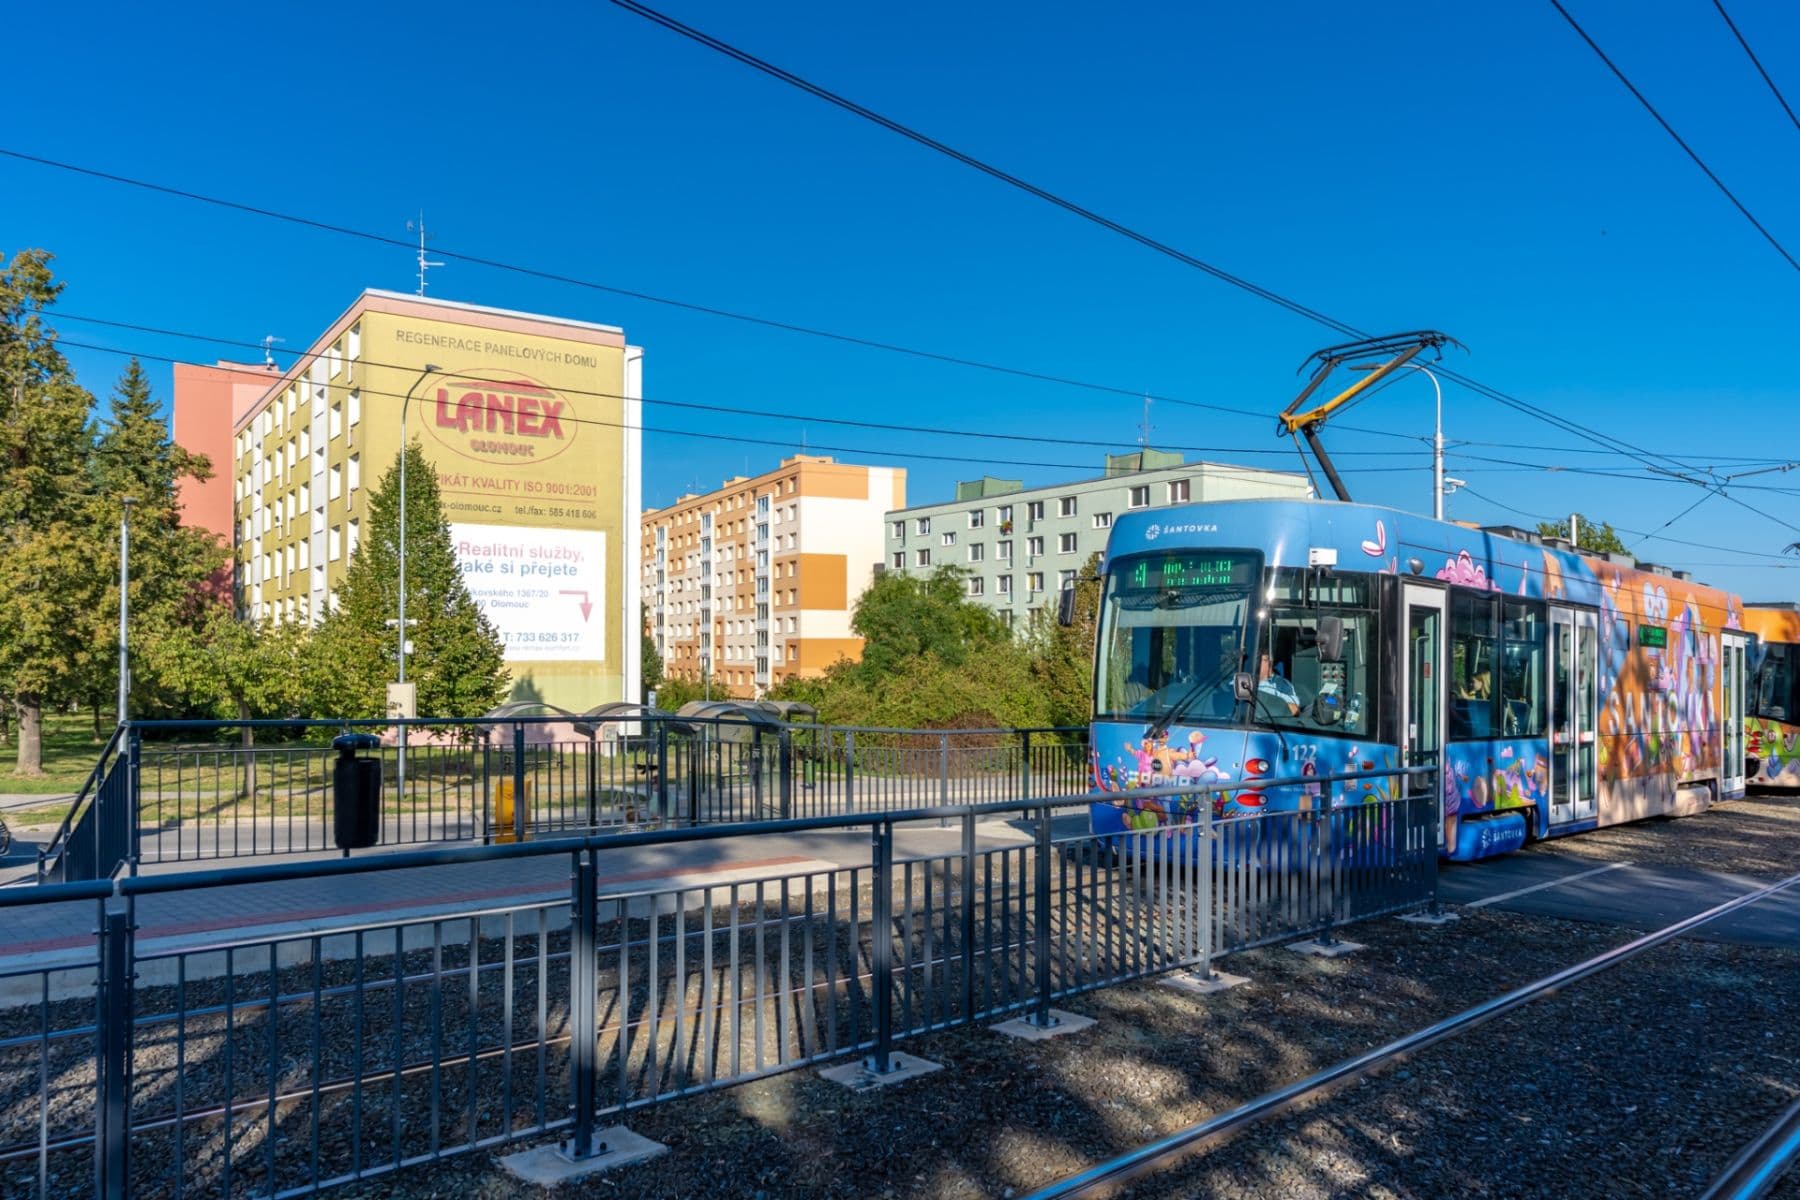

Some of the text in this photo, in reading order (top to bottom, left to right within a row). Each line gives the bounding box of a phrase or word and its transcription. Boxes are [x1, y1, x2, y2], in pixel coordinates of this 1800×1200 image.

[396, 329, 482, 353] REGENERACE
[485, 341, 562, 364] PANELOVÝCH
[436, 388, 565, 440] LANEX
[472, 476, 521, 492] KVALITY
[523, 480, 543, 493] ISO
[546, 482, 598, 497] 9001:2001
[549, 506, 564, 517] 585
[459, 541, 524, 558] Realitní
[459, 559, 578, 578] jaké si přejete
[491, 599, 529, 608] Olomouc
[516, 632, 536, 642] 733
[560, 632, 580, 642] 317
[1292, 744, 1317, 761] 122
